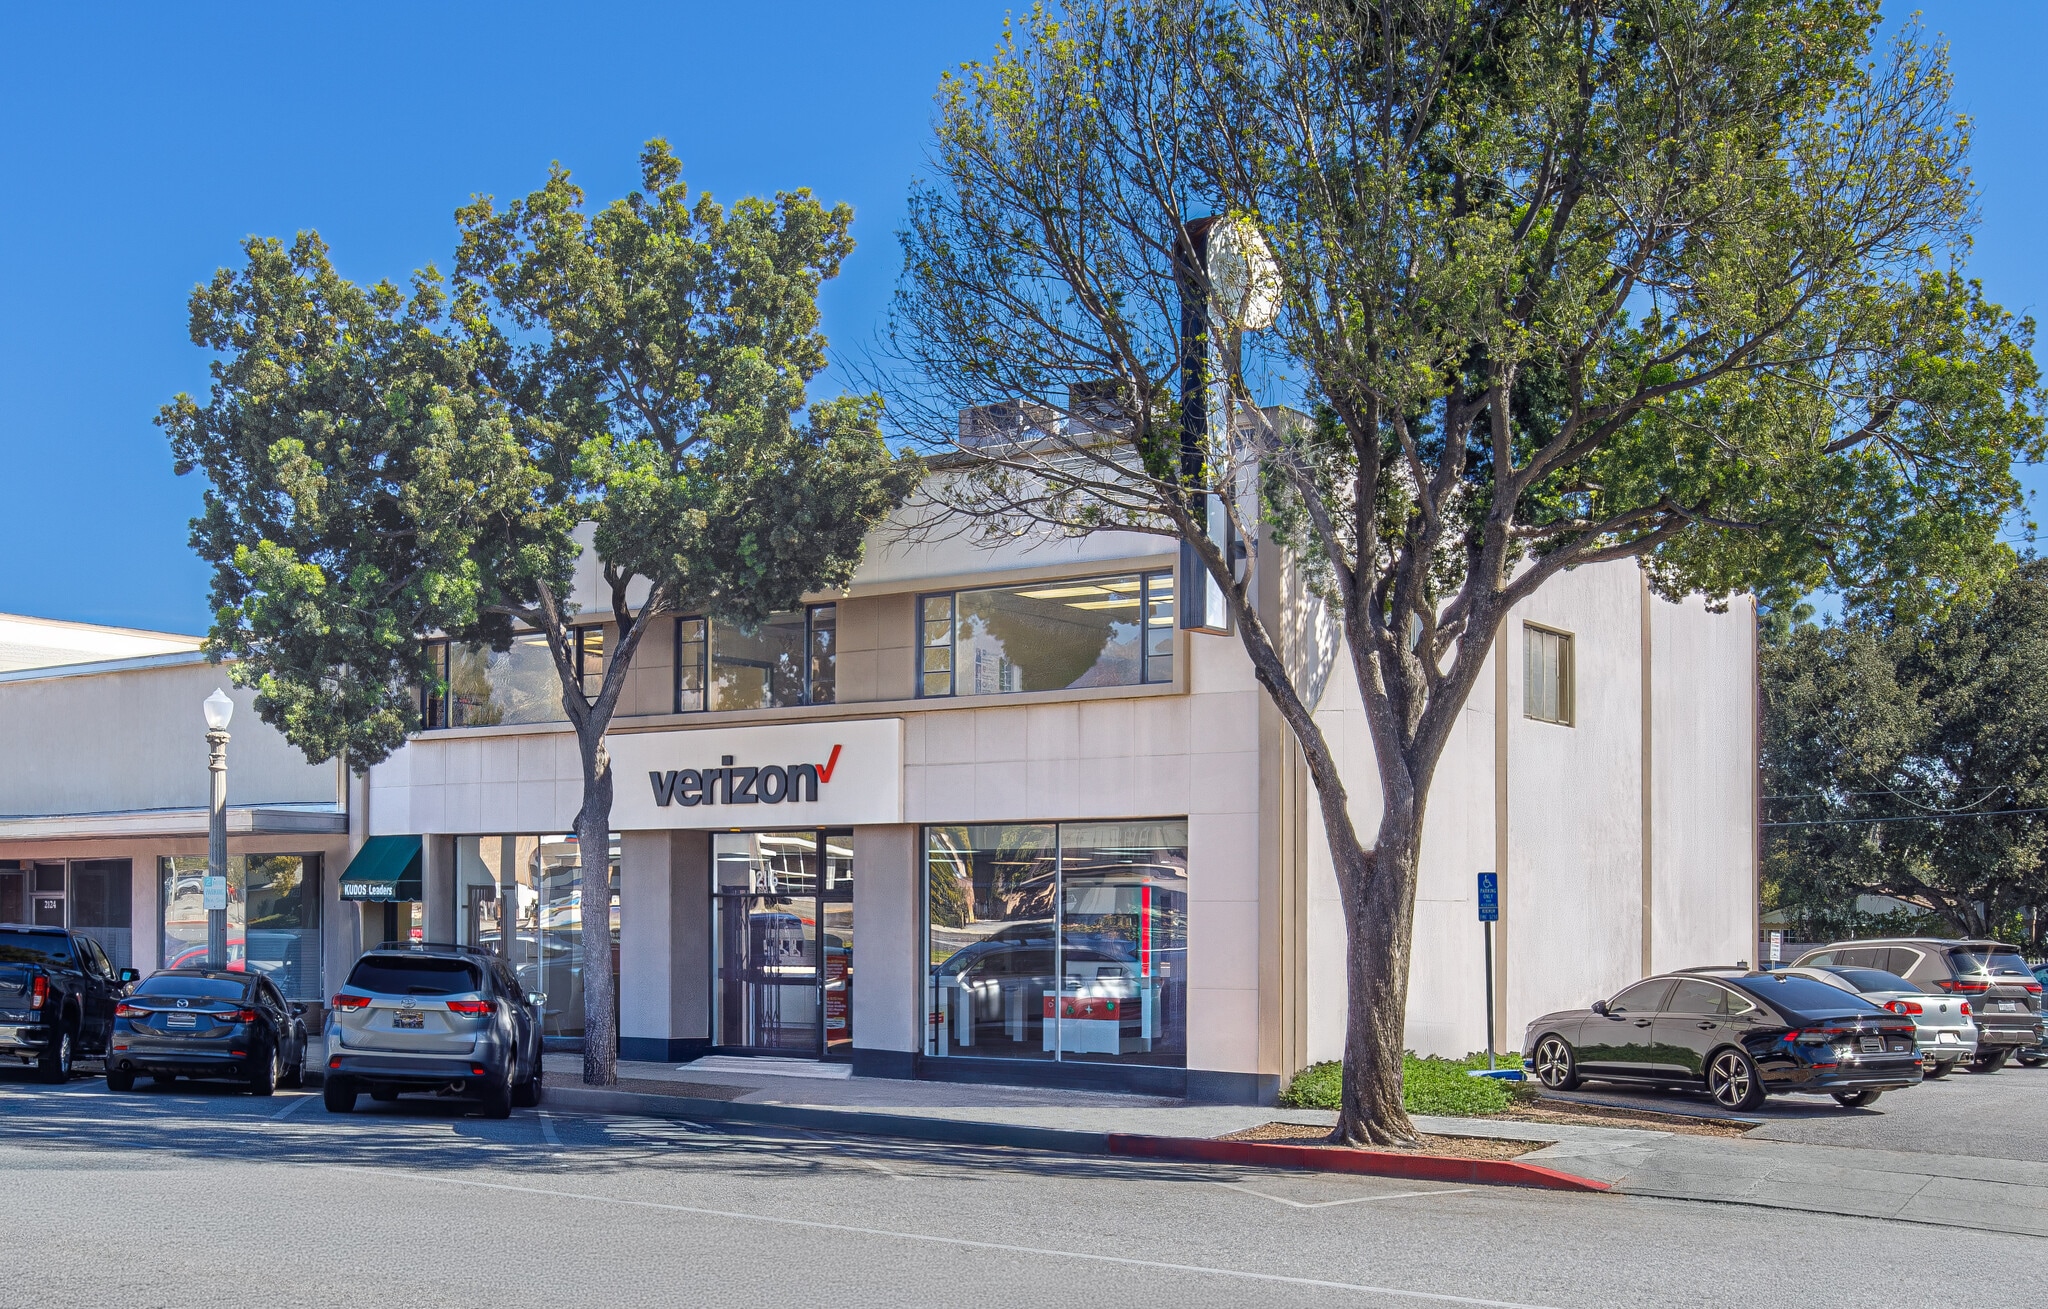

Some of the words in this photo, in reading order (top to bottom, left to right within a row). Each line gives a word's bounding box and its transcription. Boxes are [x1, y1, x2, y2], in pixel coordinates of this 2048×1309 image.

[649, 755, 818, 807] verizon
[344, 884, 367, 896] KUDOS
[368, 884, 393, 896] Leaders
[44, 900, 57, 909] 2124
